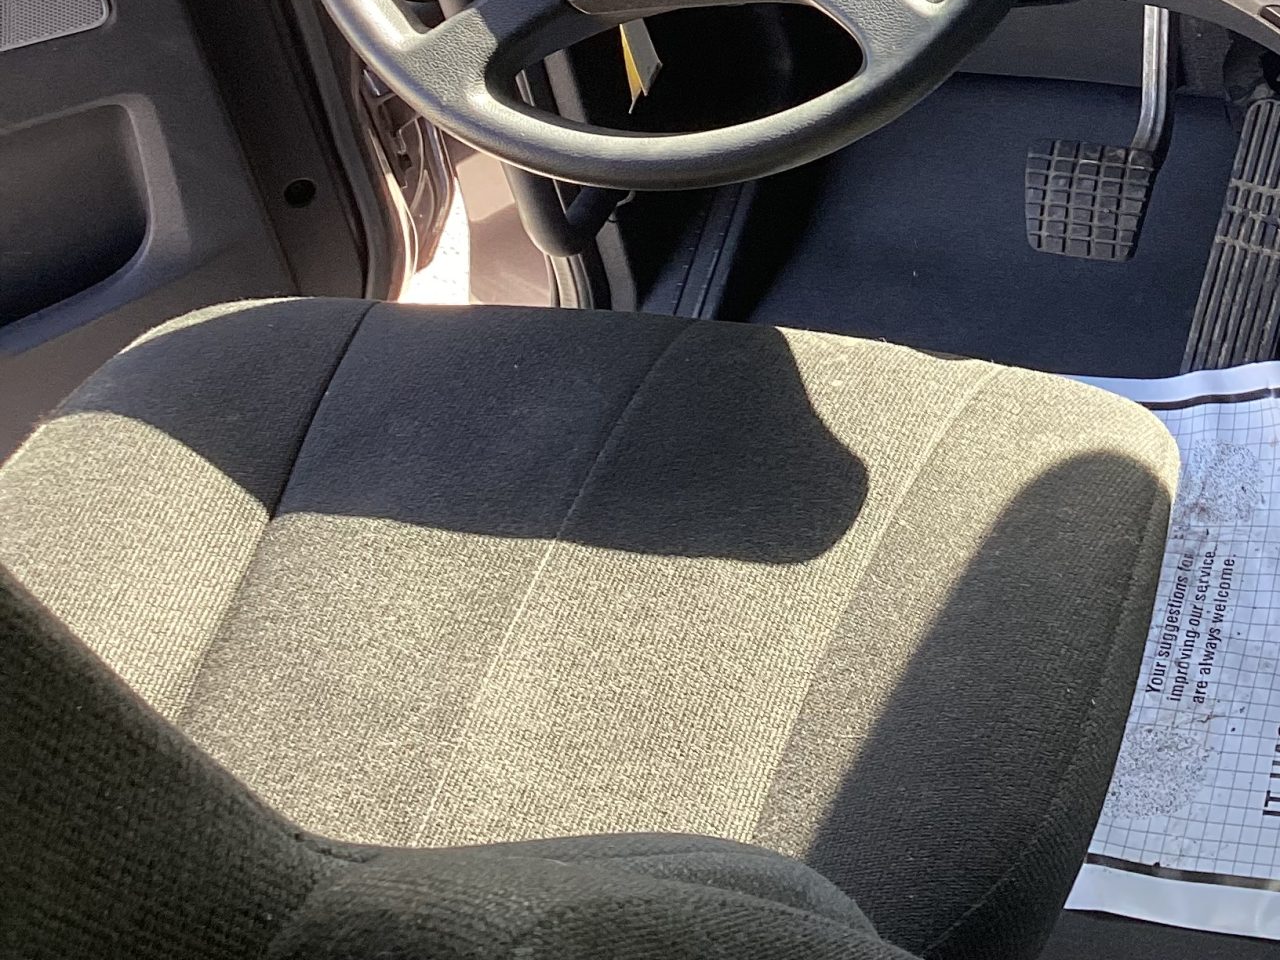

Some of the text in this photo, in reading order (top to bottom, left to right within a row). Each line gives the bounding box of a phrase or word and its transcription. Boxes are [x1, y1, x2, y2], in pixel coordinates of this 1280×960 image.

[1145, 661, 1167, 694] Your
[1157, 574, 1189, 659] suggestions
[1166, 550, 1217, 702] improving our service
[1193, 553, 1237, 705] are always welcome.
